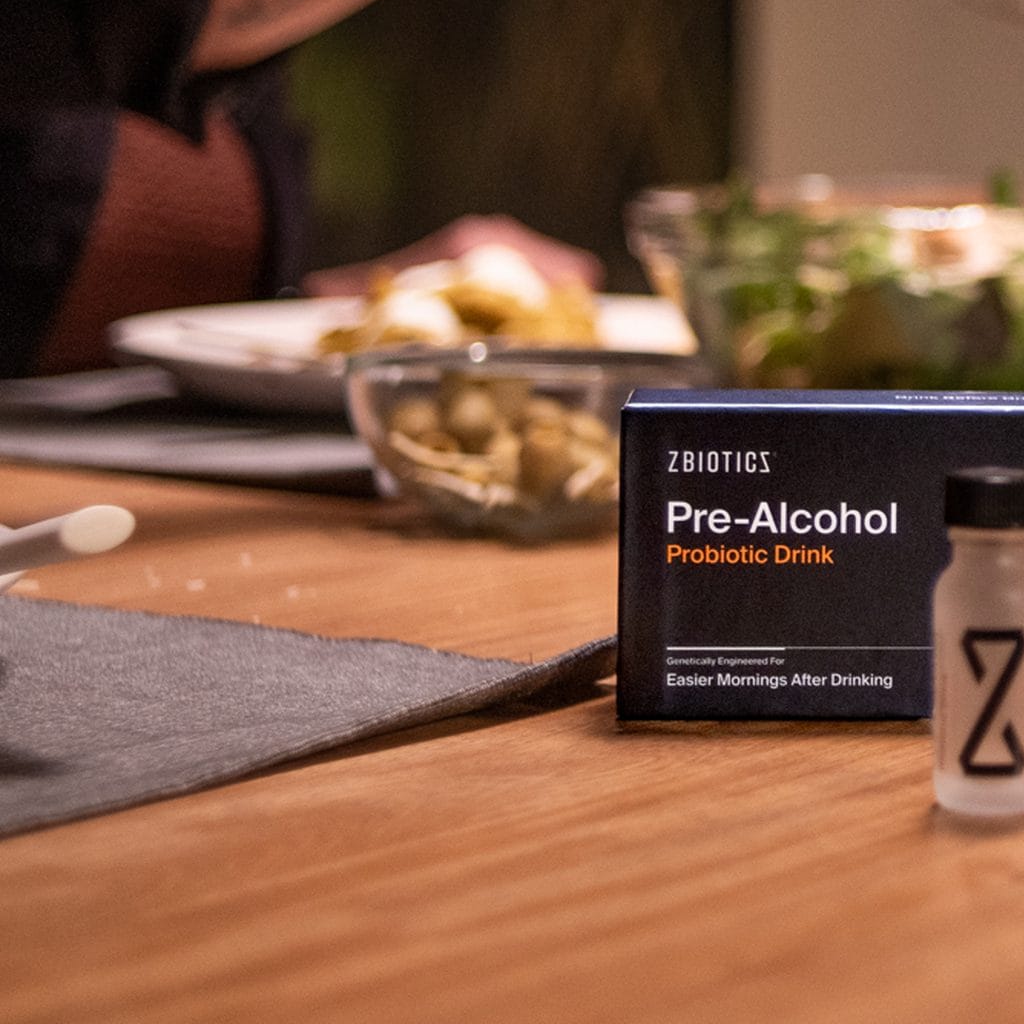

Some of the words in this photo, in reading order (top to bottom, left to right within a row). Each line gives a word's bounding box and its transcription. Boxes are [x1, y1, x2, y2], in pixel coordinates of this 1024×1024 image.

[668, 451, 770, 473] ZBIOTICS
[668, 501, 897, 534] Pre-Alcohol
[667, 545, 767, 563] Probiotic
[775, 545, 833, 563] Drink
[666, 657, 716, 666] Genetically
[718, 657, 768, 666] Engineered
[770, 657, 784, 665] For
[667, 673, 713, 686] Easier
[718, 673, 787, 689] Mornings
[791, 673, 827, 686] After
[831, 673, 892, 689] Drinking
